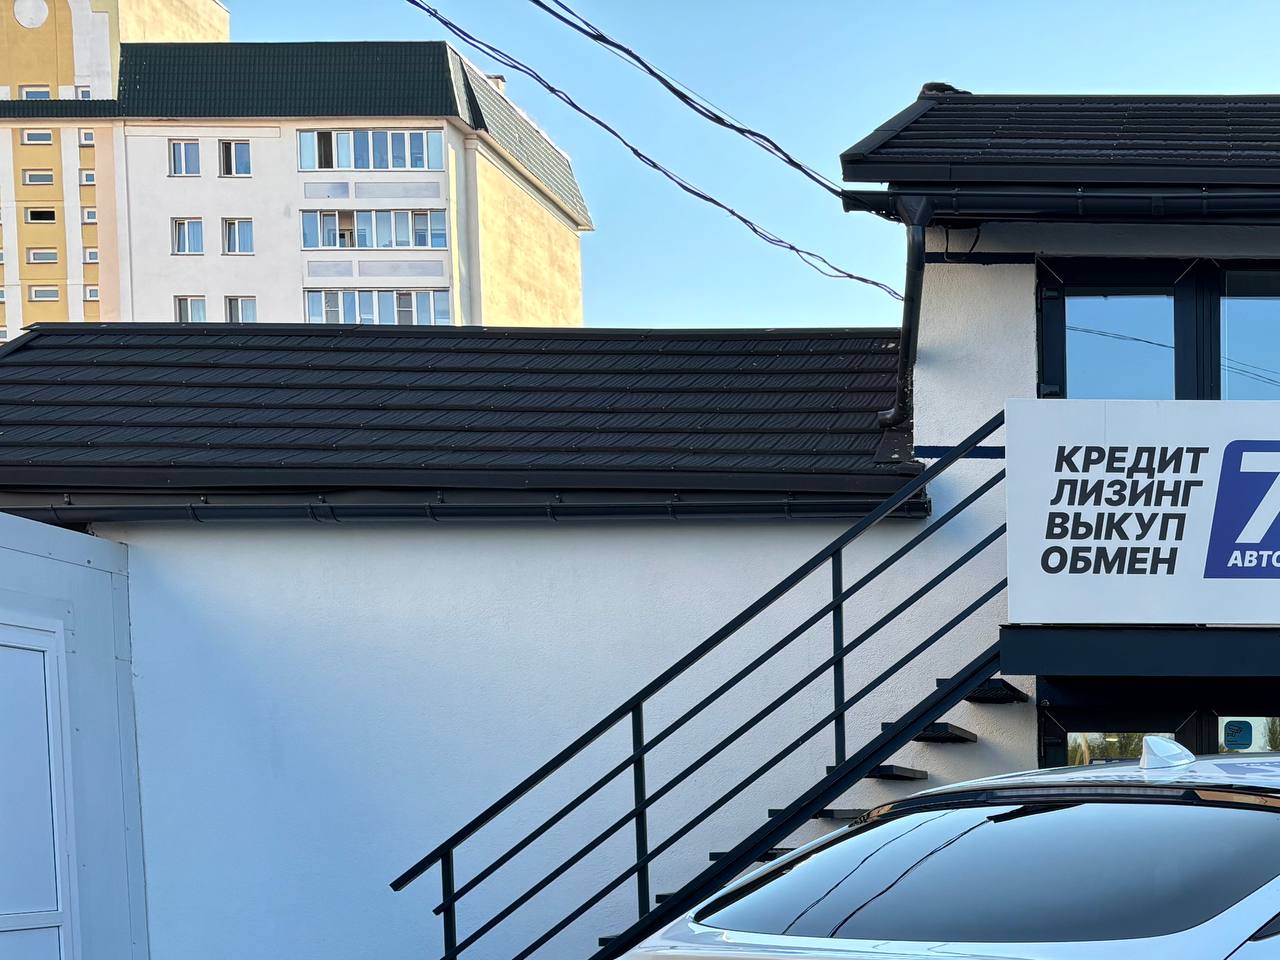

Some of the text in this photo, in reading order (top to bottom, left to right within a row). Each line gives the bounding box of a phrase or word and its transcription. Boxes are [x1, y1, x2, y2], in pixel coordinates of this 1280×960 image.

[1054, 445, 1209, 479] КРЕДИТ
[1050, 479, 1203, 507] ЛИЗИНГ
[1045, 511, 1187, 541] ВЫКУП
[1040, 545, 1179, 575] ОБМЕН
